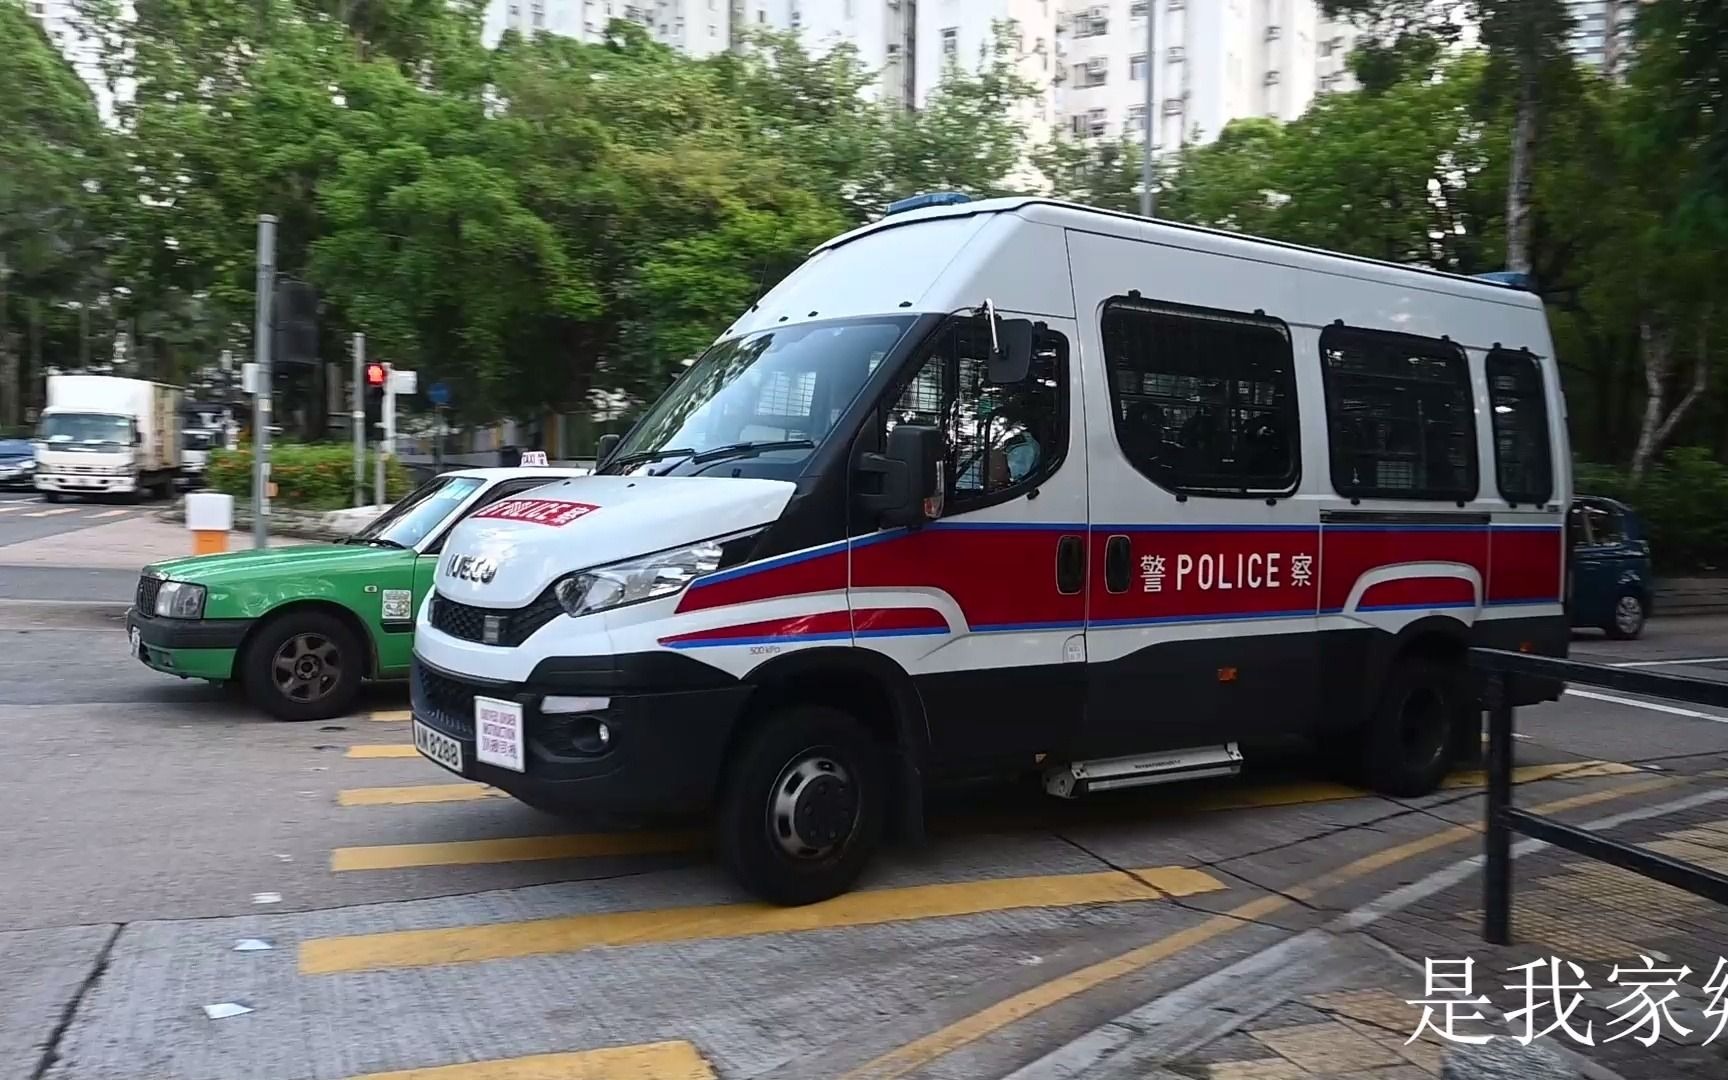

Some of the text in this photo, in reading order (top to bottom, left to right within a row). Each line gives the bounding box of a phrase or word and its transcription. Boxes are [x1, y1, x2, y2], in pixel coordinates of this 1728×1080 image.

[489, 501, 574, 521] POLICE
[445, 553, 498, 585] IVECO
[1140, 553, 1313, 593] 警 POLICE 察
[429, 732, 459, 767] 8288
